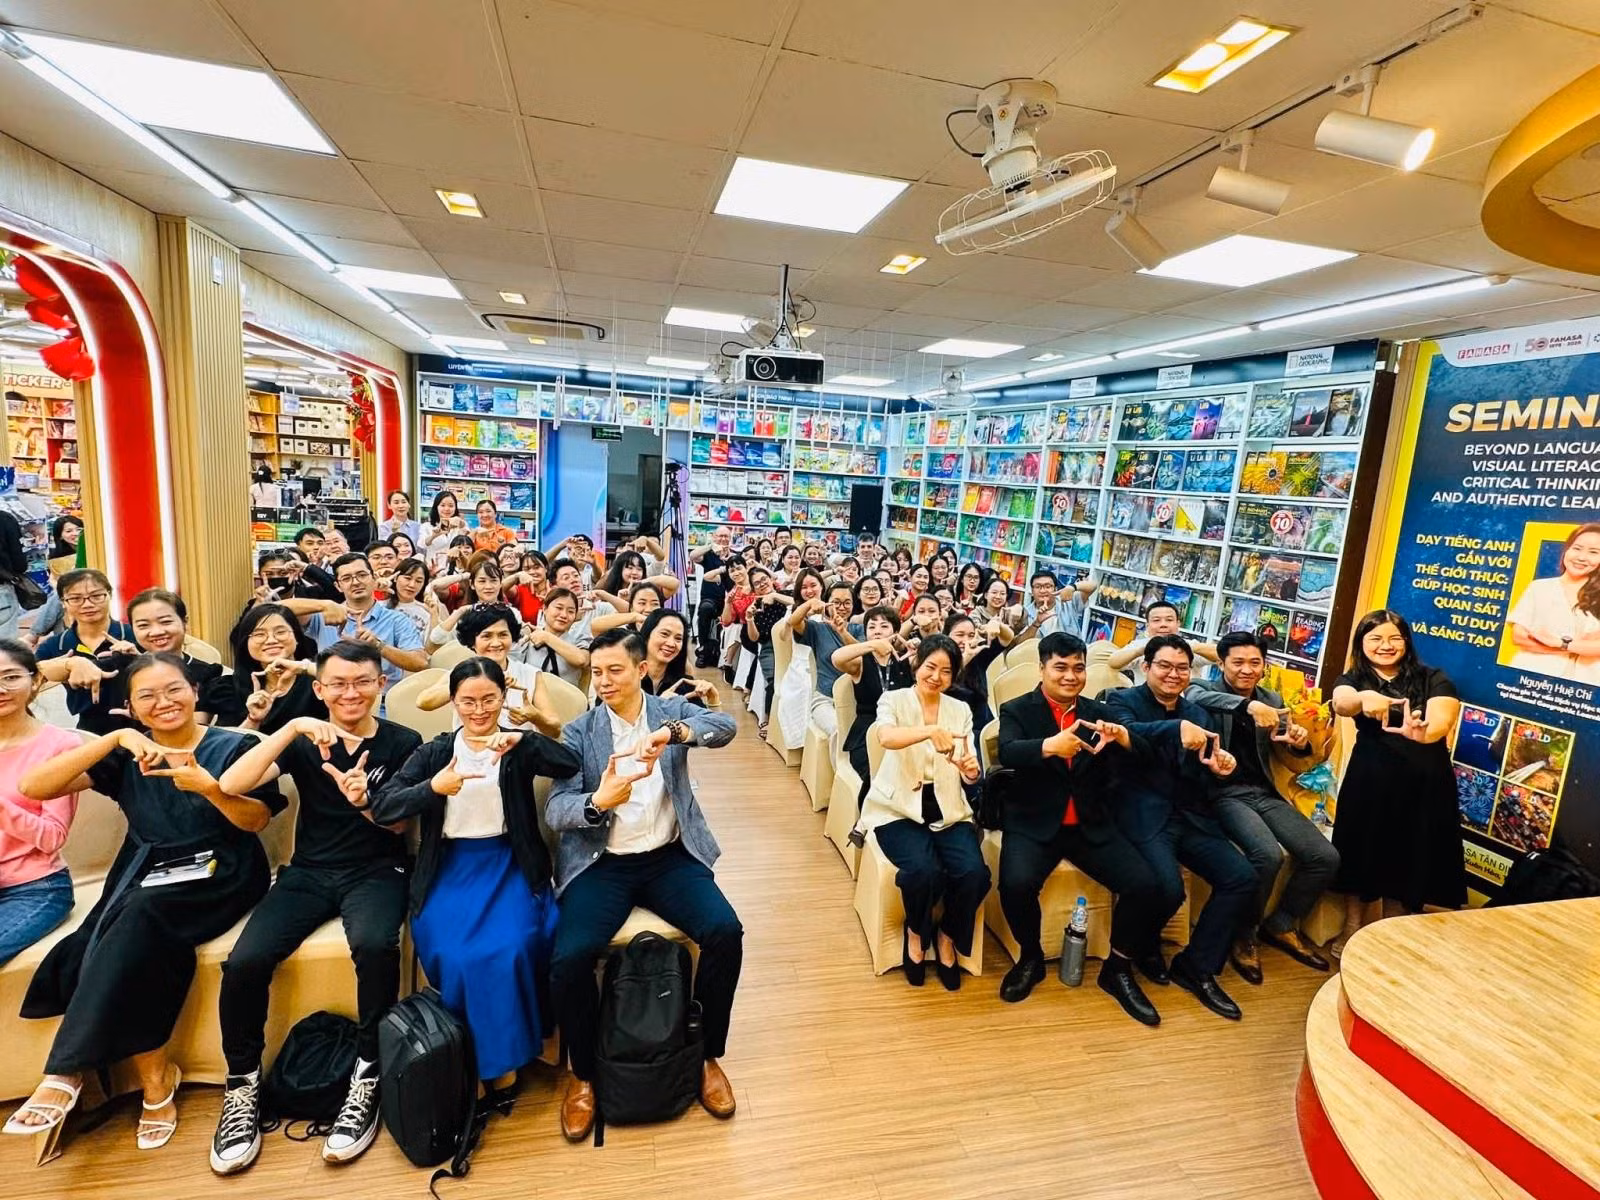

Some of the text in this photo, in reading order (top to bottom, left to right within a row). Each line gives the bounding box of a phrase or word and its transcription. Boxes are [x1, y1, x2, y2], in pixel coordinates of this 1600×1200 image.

[1549, 334, 1582, 344] FAHASA
[1457, 344, 1510, 360] FAHASA
[4, 373, 63, 389] TICKER
[1445, 394, 1600, 433] SEMIN
[1464, 443, 1530, 456] BEYOND
[1472, 460, 1600, 473] VISUAL LITERAC
[1462, 476, 1531, 489] CRITICAL
[1431, 491, 1464, 503] AND
[1466, 493, 1558, 508] AUTHENTIC
[1274, 517, 1290, 528] 10
[1416, 533, 1516, 552] DẠY TIẾNG ANH
[1487, 555, 1513, 568] VỚI
[1415, 563, 1508, 585] THẾ GIỚI THỰC:
[1412, 578, 1506, 600] GIÚP HỌC SINH
[1433, 596, 1501, 617] QUAN SÁT,
[1295, 617, 1325, 629] READING
[1450, 614, 1500, 632] TƯ DUY
[1411, 621, 1496, 648] VÀ SÁNG TẠO
[1554, 683, 1574, 698] Huệ
[1464, 848, 1477, 860] SA
[1479, 853, 1497, 868] TÂN
